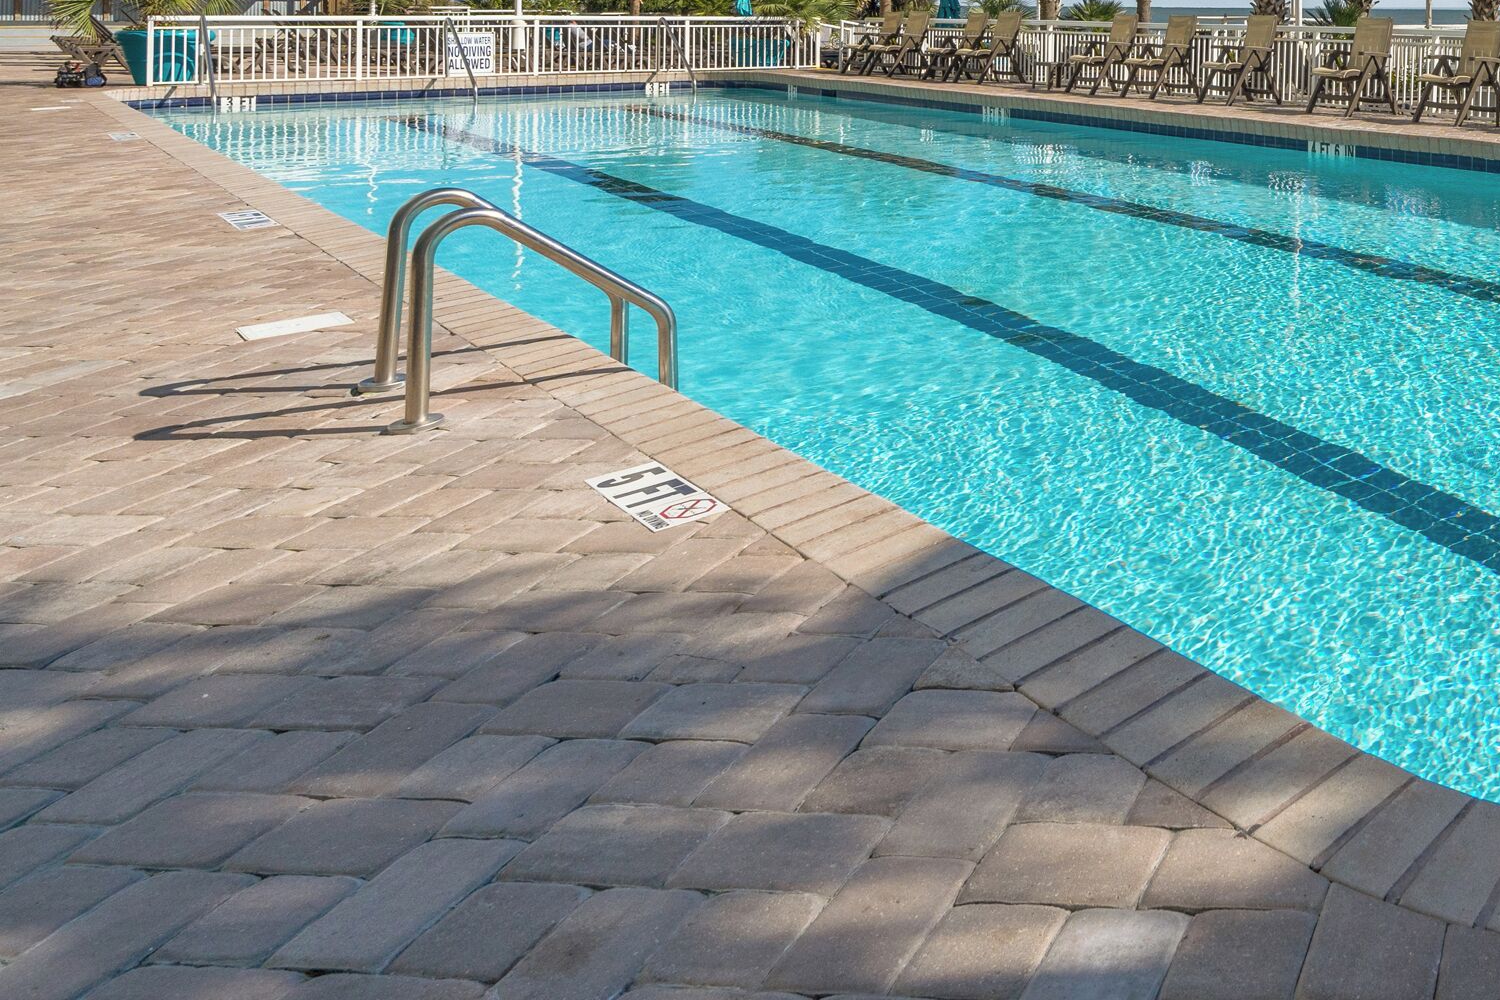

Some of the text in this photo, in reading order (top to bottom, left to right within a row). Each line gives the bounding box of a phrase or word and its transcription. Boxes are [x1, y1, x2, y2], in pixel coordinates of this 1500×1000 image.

[474, 36, 491, 44] WATER
[447, 45, 492, 57] NO DIVING
[1310, 140, 1355, 158] 4 FT 6 IN
[596, 466, 698, 509] 5 FT
[636, 510, 670, 530] NO DIVING
